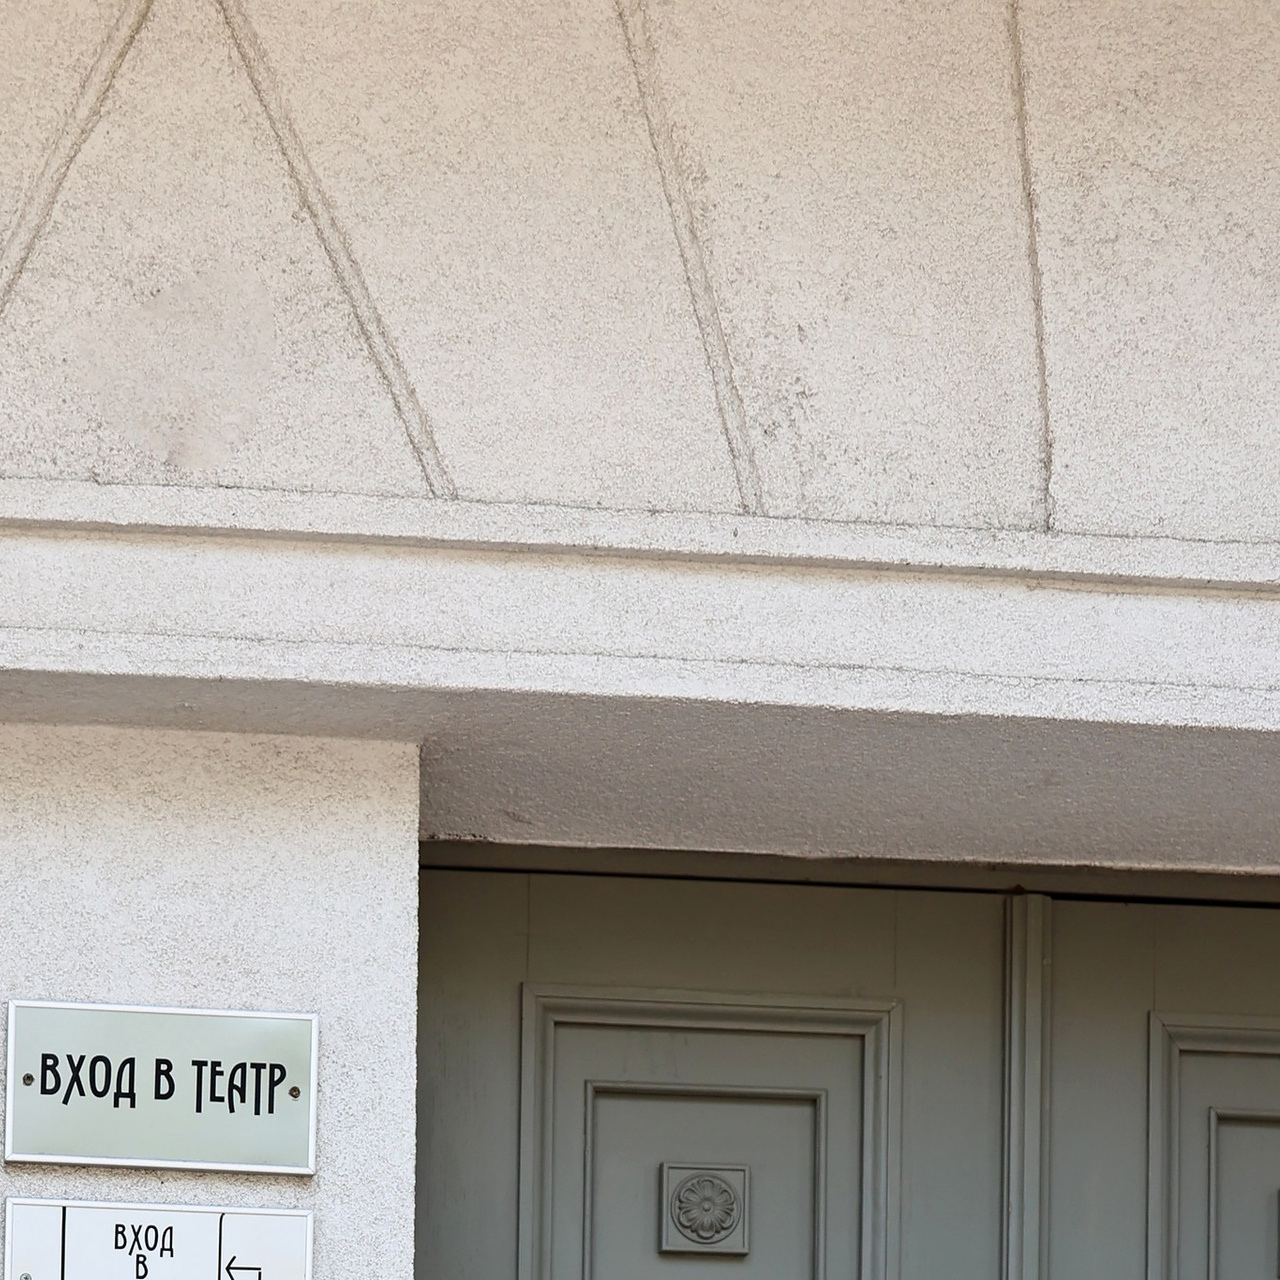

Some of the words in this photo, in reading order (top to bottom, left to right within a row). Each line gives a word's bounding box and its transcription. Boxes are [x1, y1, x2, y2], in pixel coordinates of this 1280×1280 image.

[40, 1053, 136, 1108] ВХОД
[154, 1058, 175, 1100] В
[192, 1060, 287, 1115] ТЕАТР
[114, 1223, 174, 1258] ВХОД
[135, 1254, 149, 1279] В
